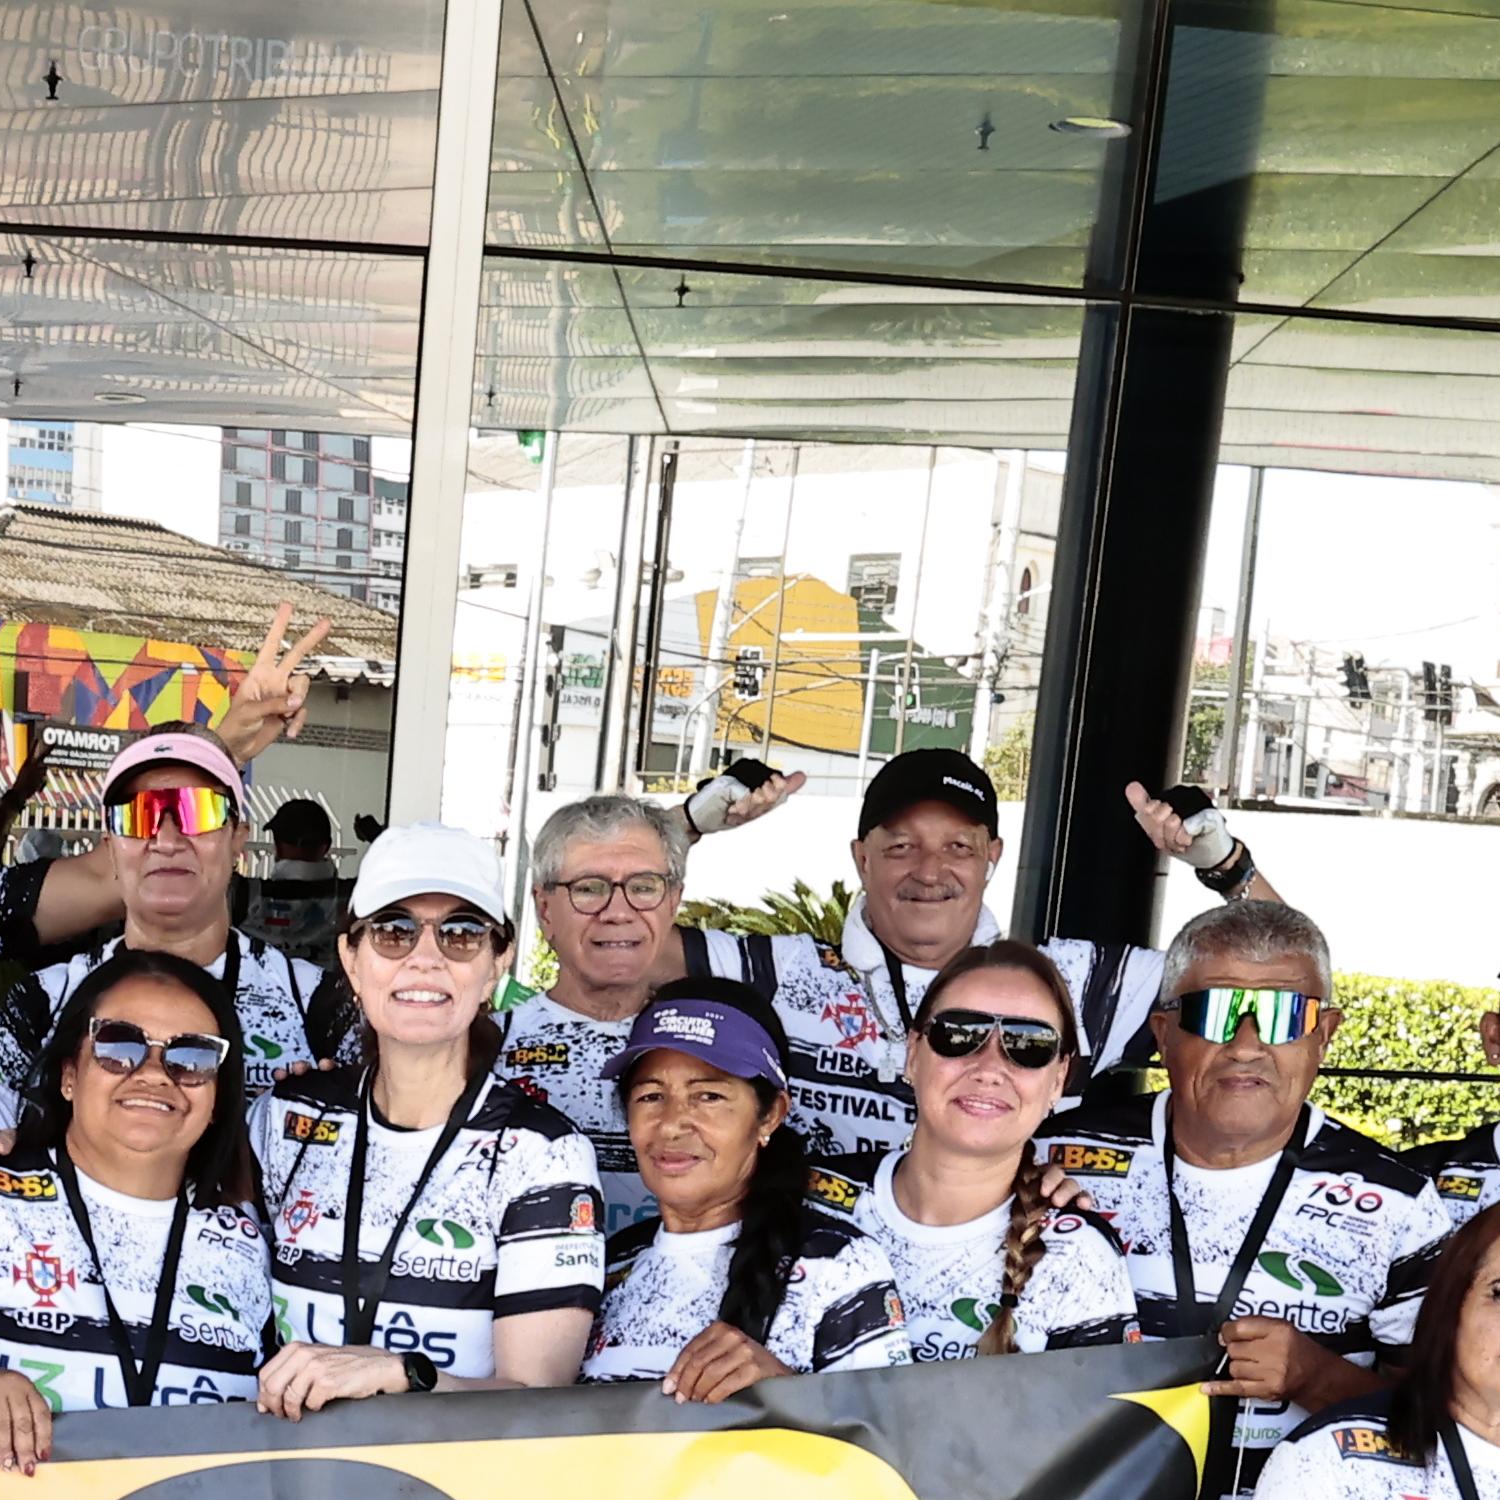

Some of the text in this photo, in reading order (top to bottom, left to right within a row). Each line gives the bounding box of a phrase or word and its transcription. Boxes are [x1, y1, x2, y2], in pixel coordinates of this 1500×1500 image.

[1295, 1204, 1343, 1228] FPC
[393, 1251, 482, 1281] Serttel
[17, 1310, 71, 1331] HBP
